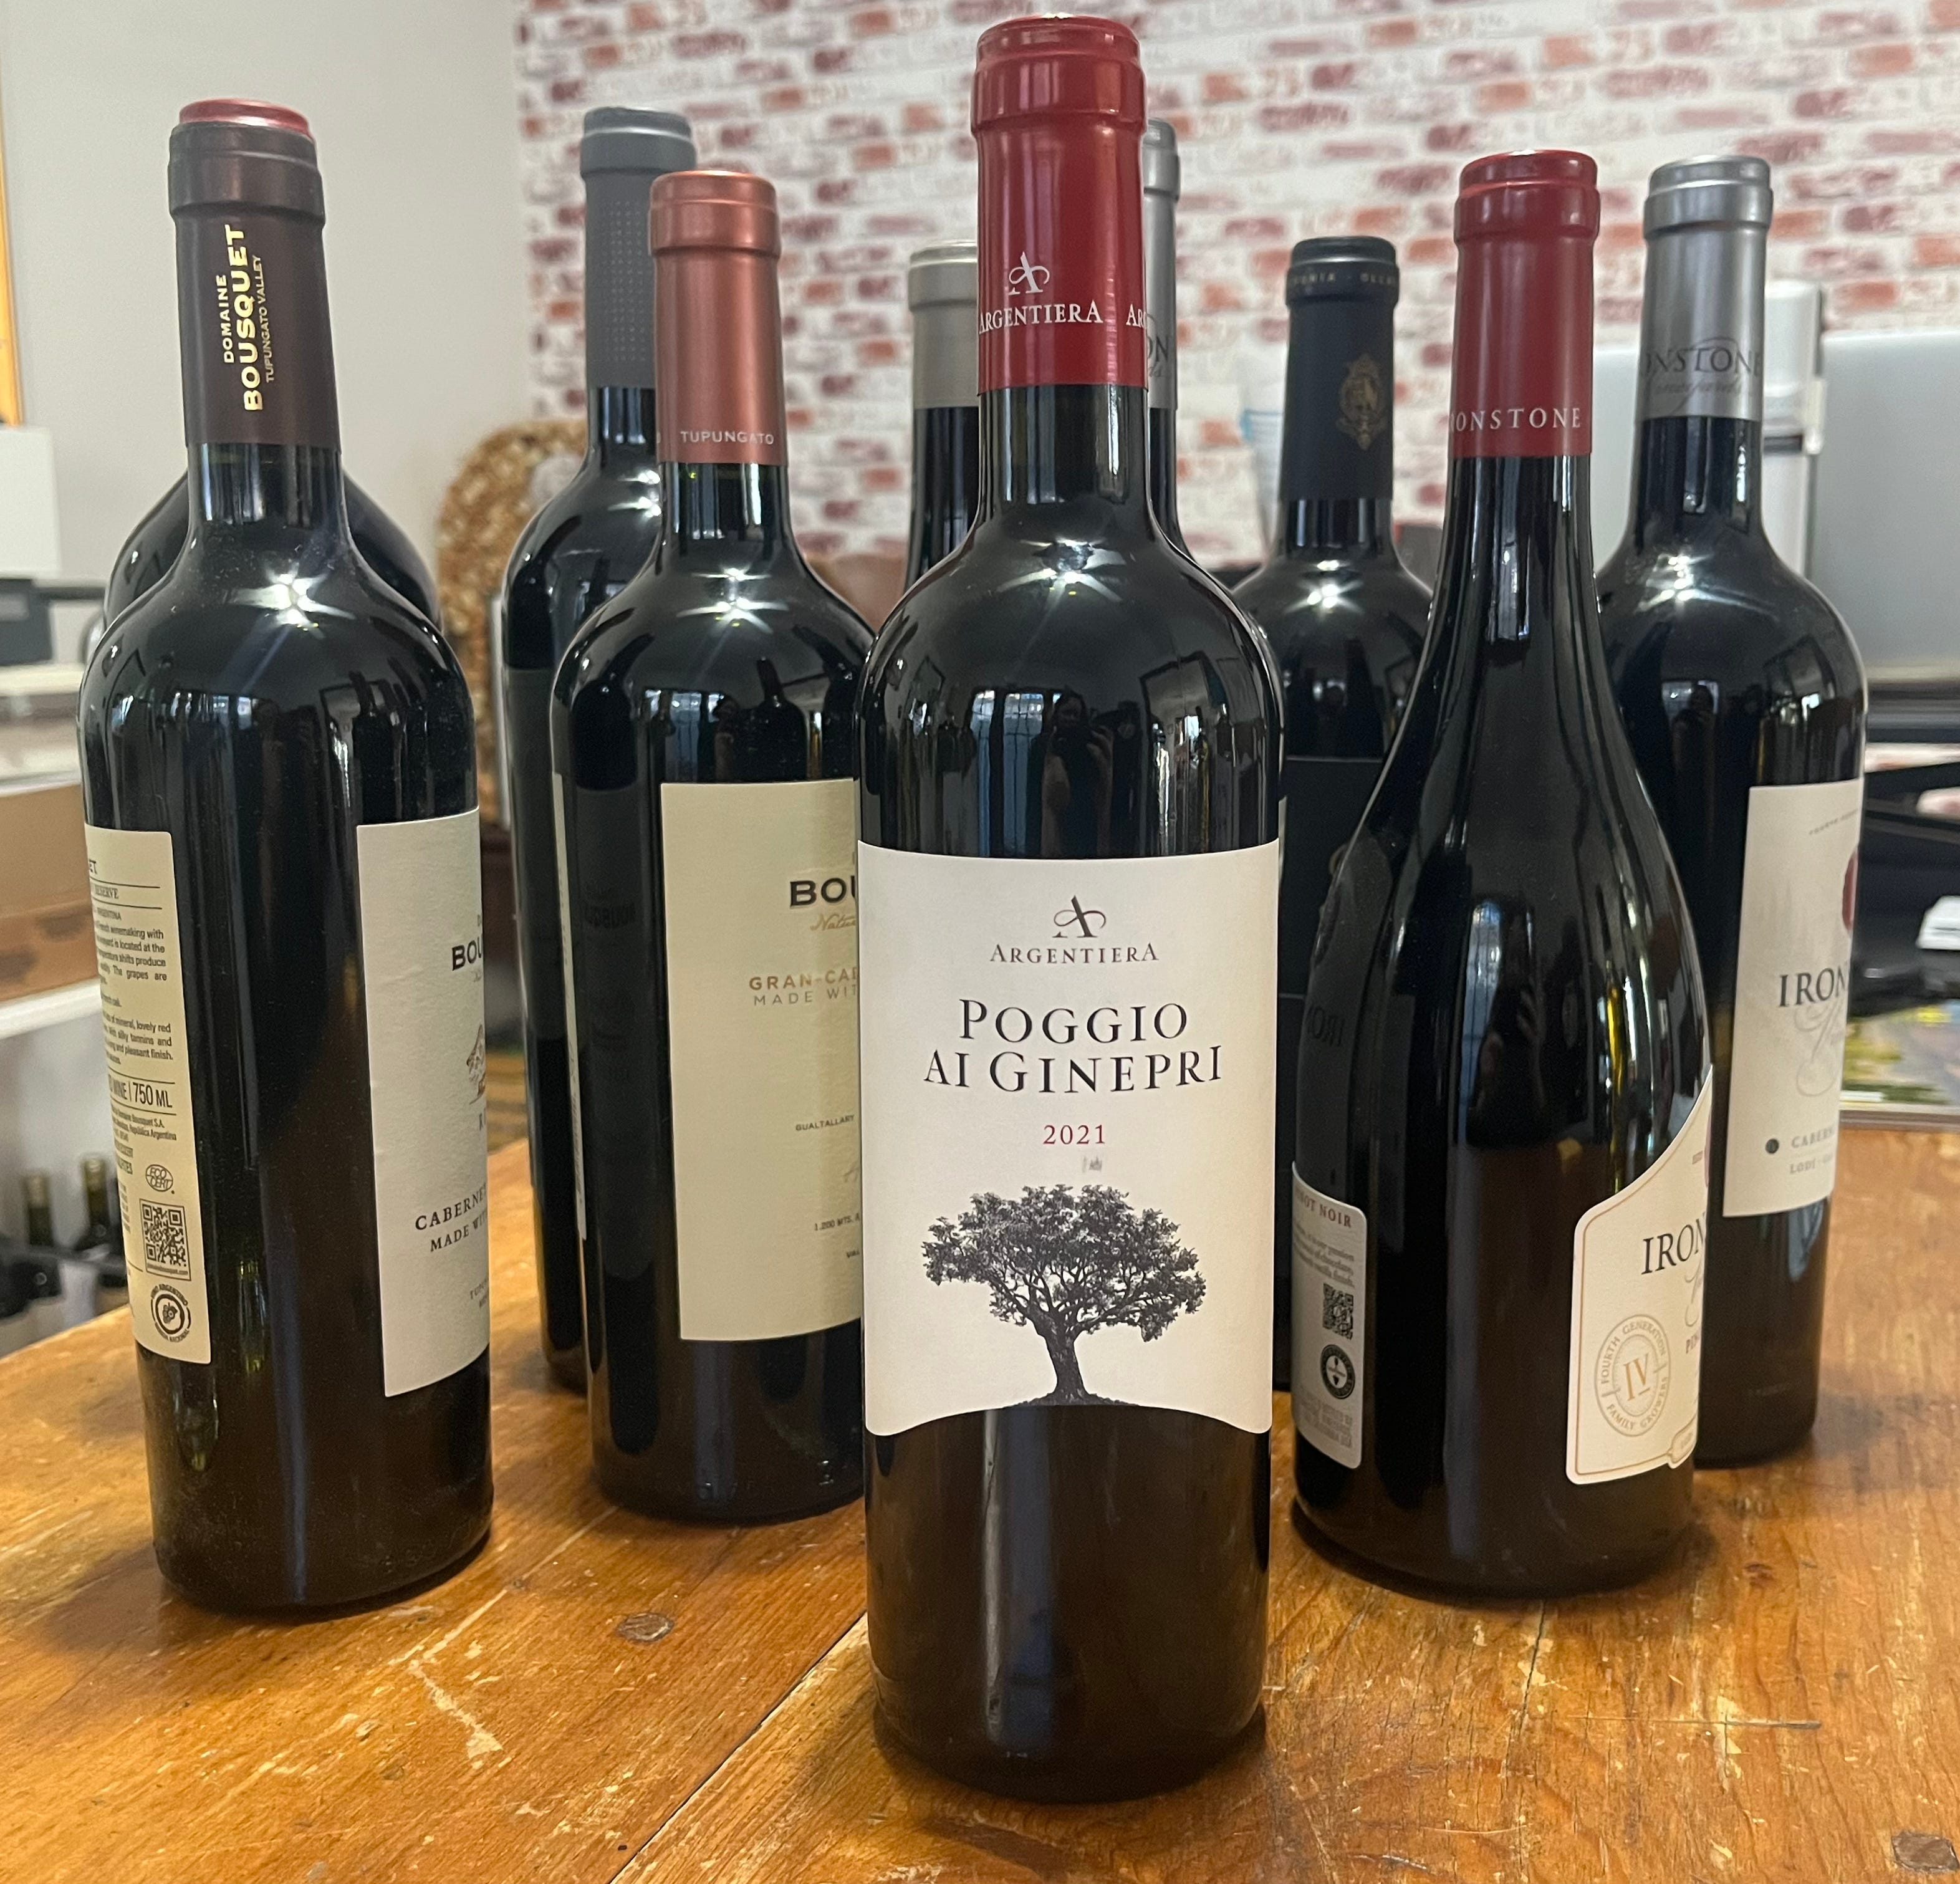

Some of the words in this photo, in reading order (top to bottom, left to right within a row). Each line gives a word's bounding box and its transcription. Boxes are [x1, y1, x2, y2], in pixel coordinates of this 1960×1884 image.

[252, 254, 266, 304] VALLEY
[216, 274, 234, 363] DOMAINE
[224, 224, 263, 411] BOUSQUET
[978, 299, 1103, 334] ARGENTIERA
[258, 306, 274, 383] TUPUNGATO
[680, 431, 774, 445] TUPUNGATO
[147, 928, 164, 940] with
[120, 940, 142, 951] located
[143, 943, 151, 952] at
[152, 943, 165, 953] the
[989, 942, 1160, 964] ARGENTIERA
[135, 956, 166, 967] produce
[127, 969, 149, 980] grapes
[154, 973, 167, 981] are
[754, 990, 814, 1006] MADE
[136, 1019, 156, 1034] lovely
[158, 1022, 171, 1033] red
[958, 998, 1188, 1044] POGGIO
[125, 1045, 150, 1058] pleasant
[151, 1049, 173, 1060] finish.
[158, 1036, 172, 1047] and
[923, 1049, 970, 1087] AI
[989, 1044, 1223, 1093] GINEPRI
[133, 1082, 153, 1106] 750
[155, 1089, 173, 1108] ML
[1042, 1124, 1106, 1145] 2021
[150, 1167, 167, 1180] ECO
[1319, 1204, 1352, 1228] NOIR
[430, 1224, 470, 1252] MADE
[1600, 1335, 1621, 1385] FOURTH
[1622, 1321, 1666, 1357] GENERATION
[1623, 1352, 1649, 1401] IV
[1607, 1403, 1636, 1431] FAMILY
[1639, 1376, 1669, 1428] GROWERS
